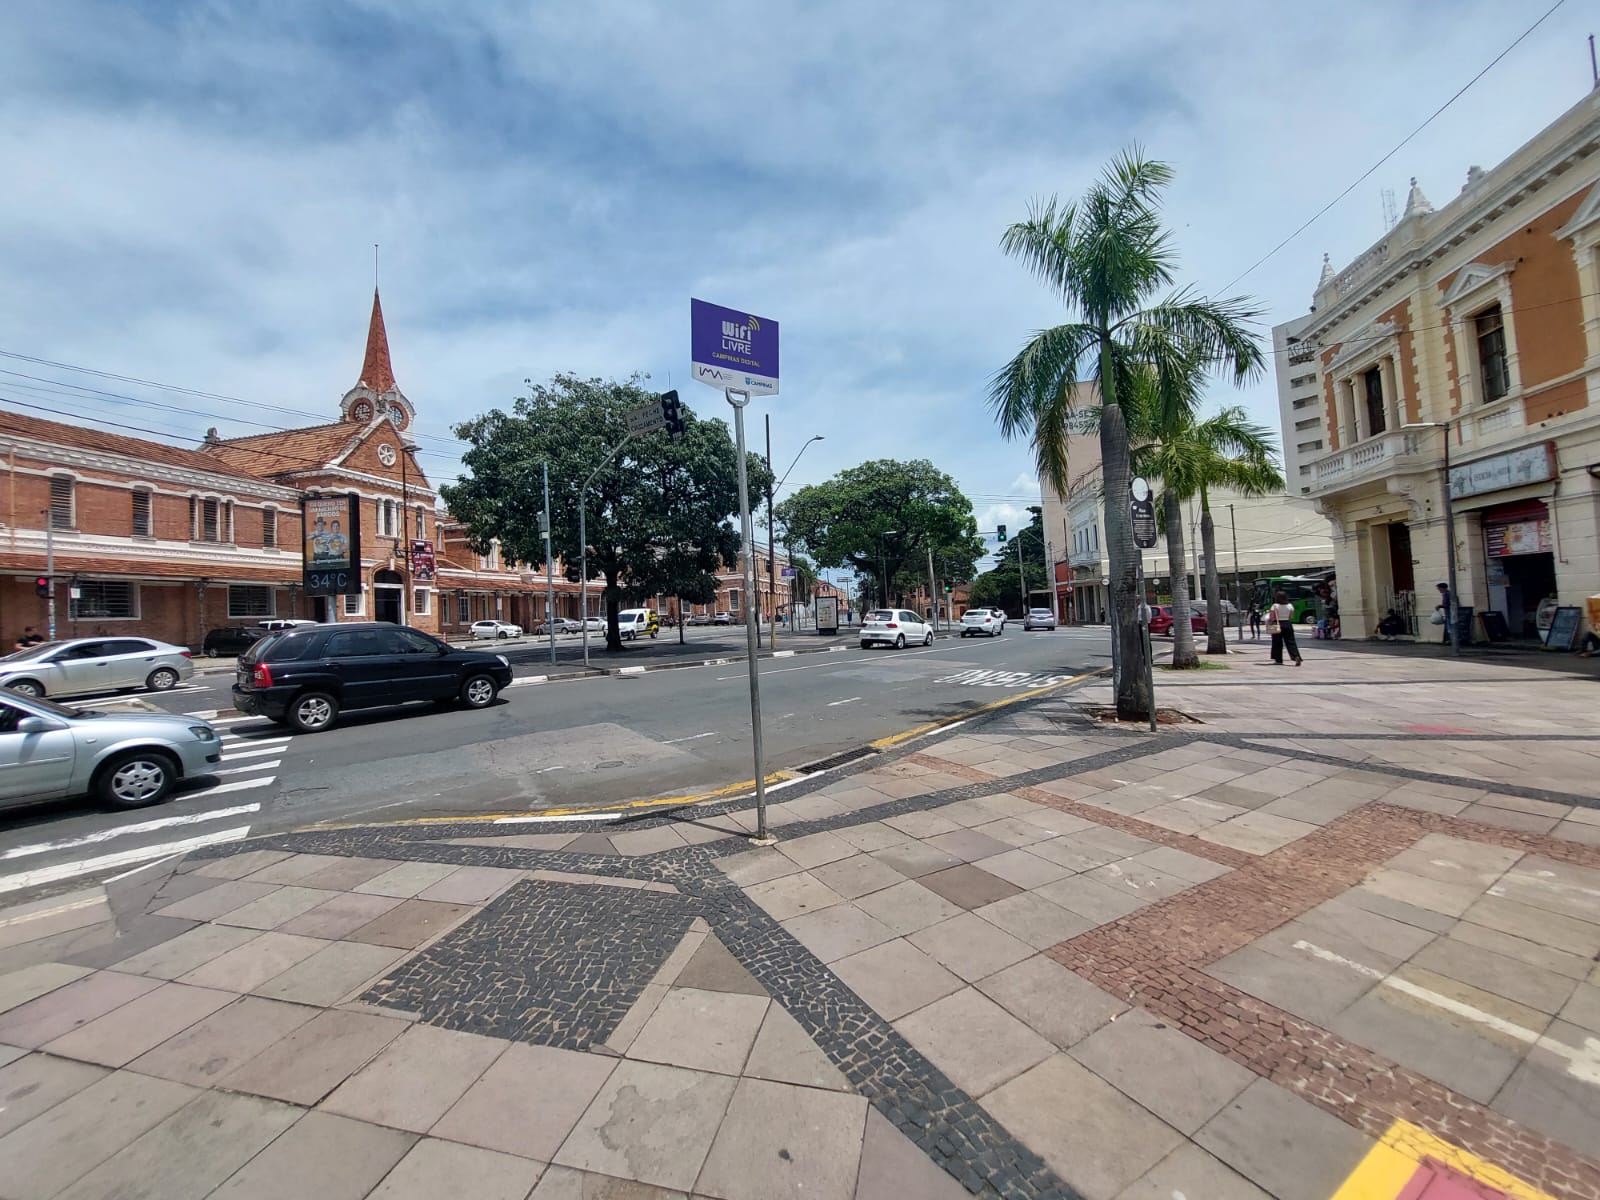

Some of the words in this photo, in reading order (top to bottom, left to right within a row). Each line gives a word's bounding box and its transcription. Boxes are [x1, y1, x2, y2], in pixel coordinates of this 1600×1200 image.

[722, 338, 752, 355] LIVRE
[712, 351, 740, 363] CAMPINAS
[741, 357, 760, 367] DIGITAL
[311, 572, 347, 588] 34°C
